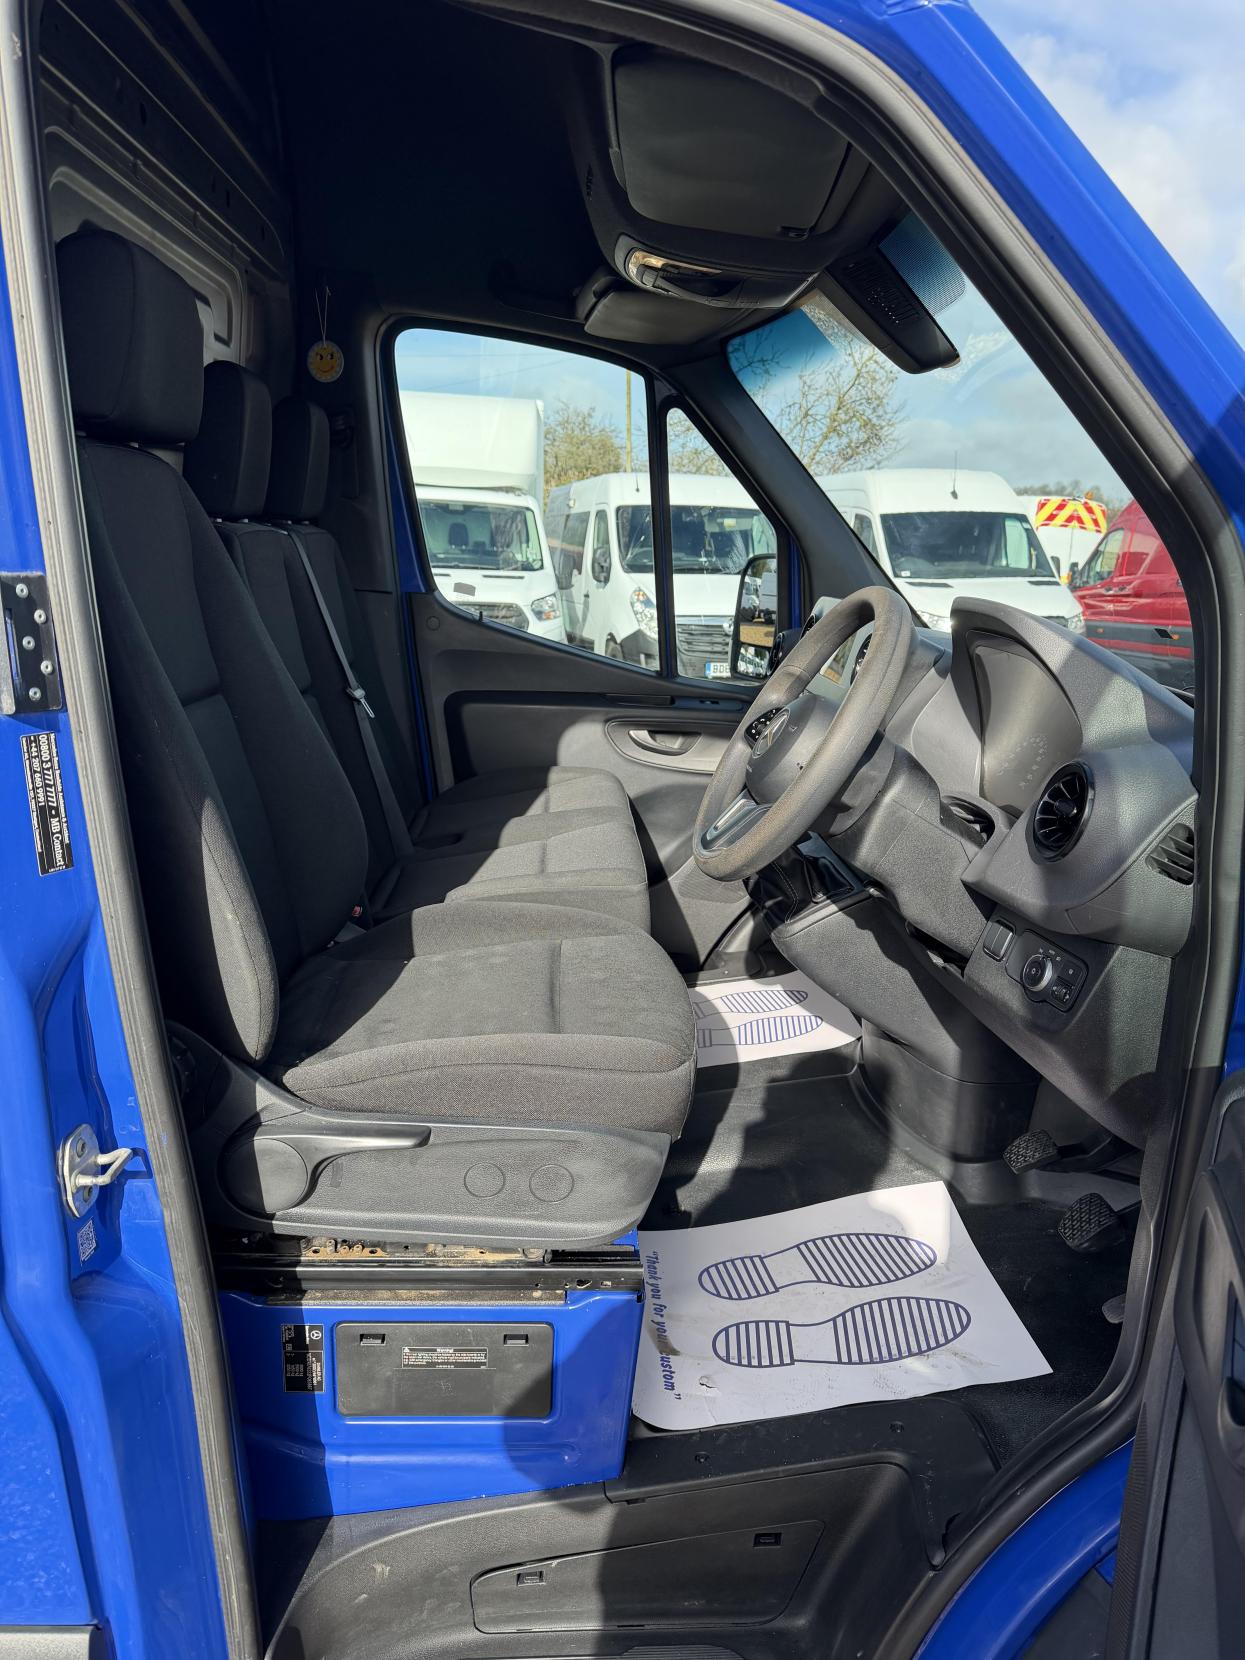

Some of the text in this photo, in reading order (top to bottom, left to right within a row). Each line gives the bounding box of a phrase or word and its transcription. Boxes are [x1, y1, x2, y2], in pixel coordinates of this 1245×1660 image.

[30, 742, 38, 756] +44
[38, 734, 50, 761] 00800
[32, 757, 40, 772] 207
[34, 772, 42, 787] 660
[43, 769, 54, 785] 777
[36, 787, 45, 806] 9991
[46, 786, 57, 807] 7777
[50, 817, 61, 832] MB
[52, 833, 66, 866] Contact
[646, 1281, 661, 1299] you
[652, 1303, 667, 1318] for
[651, 1320, 669, 1347] your
